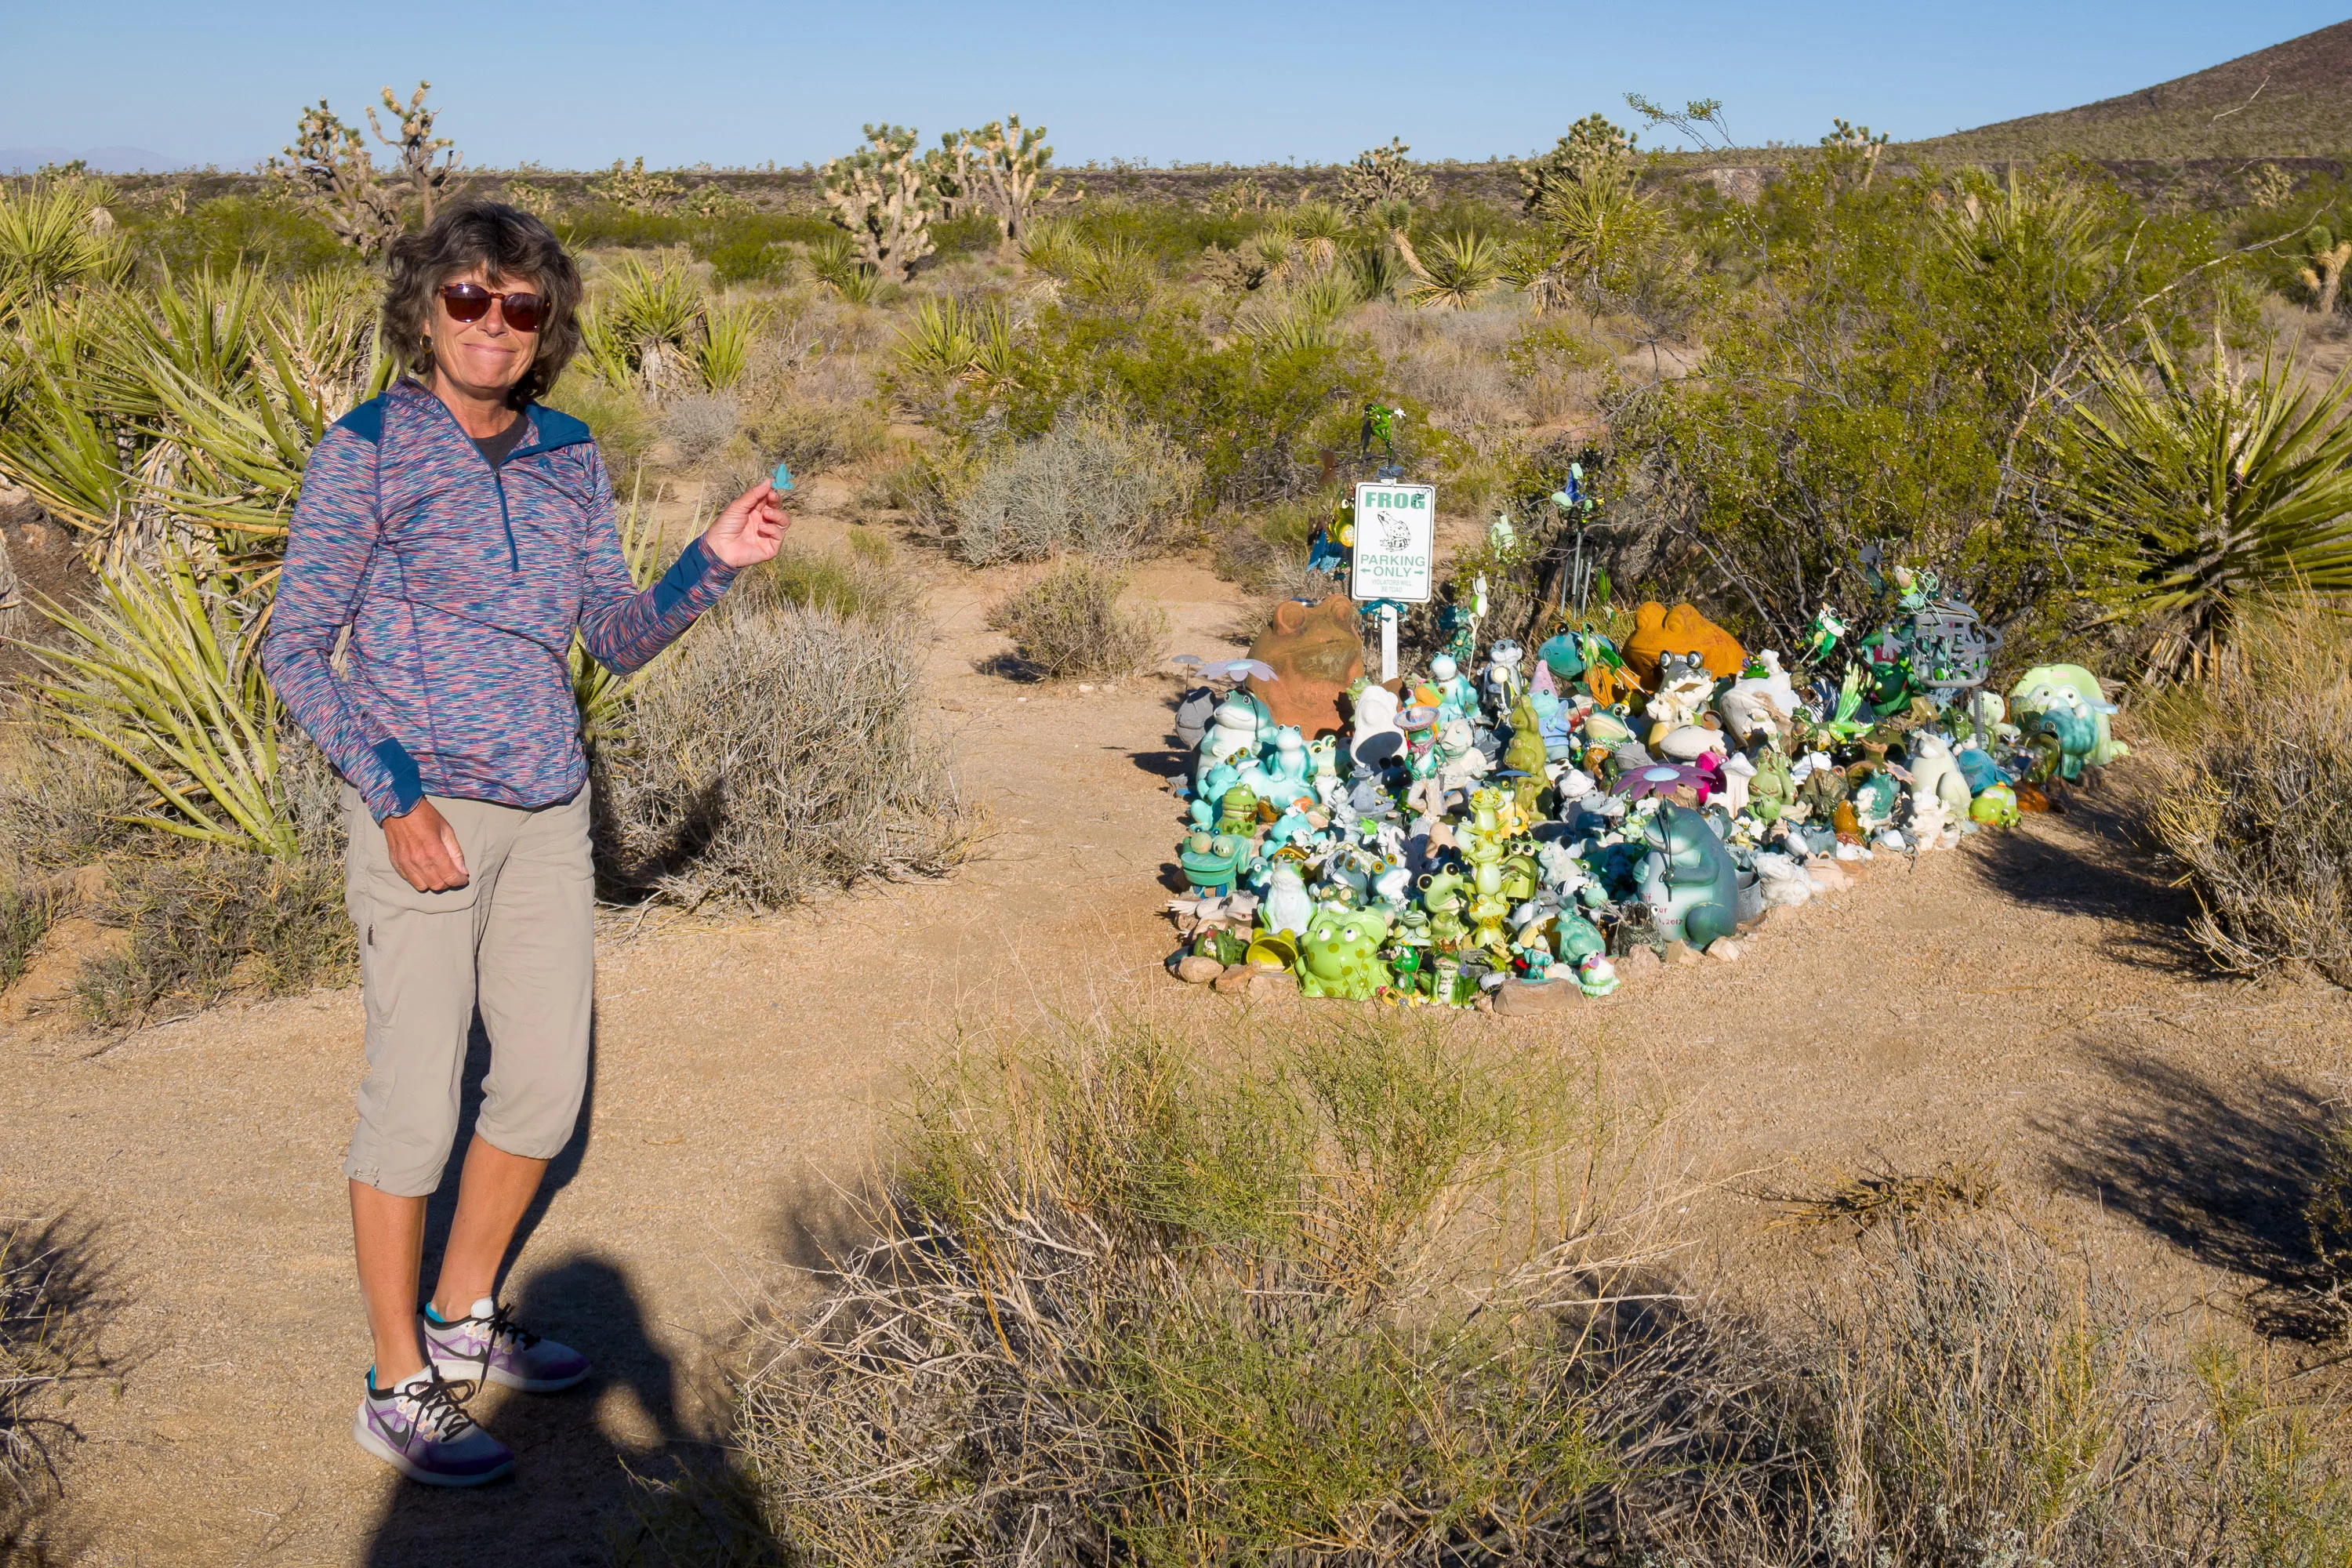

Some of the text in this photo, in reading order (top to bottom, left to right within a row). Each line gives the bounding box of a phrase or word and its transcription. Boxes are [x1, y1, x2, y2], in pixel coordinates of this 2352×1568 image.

[1365, 492, 1425, 510] FROG
[1360, 554, 1425, 567] PARKING
[1373, 566, 1411, 577] ONLY
